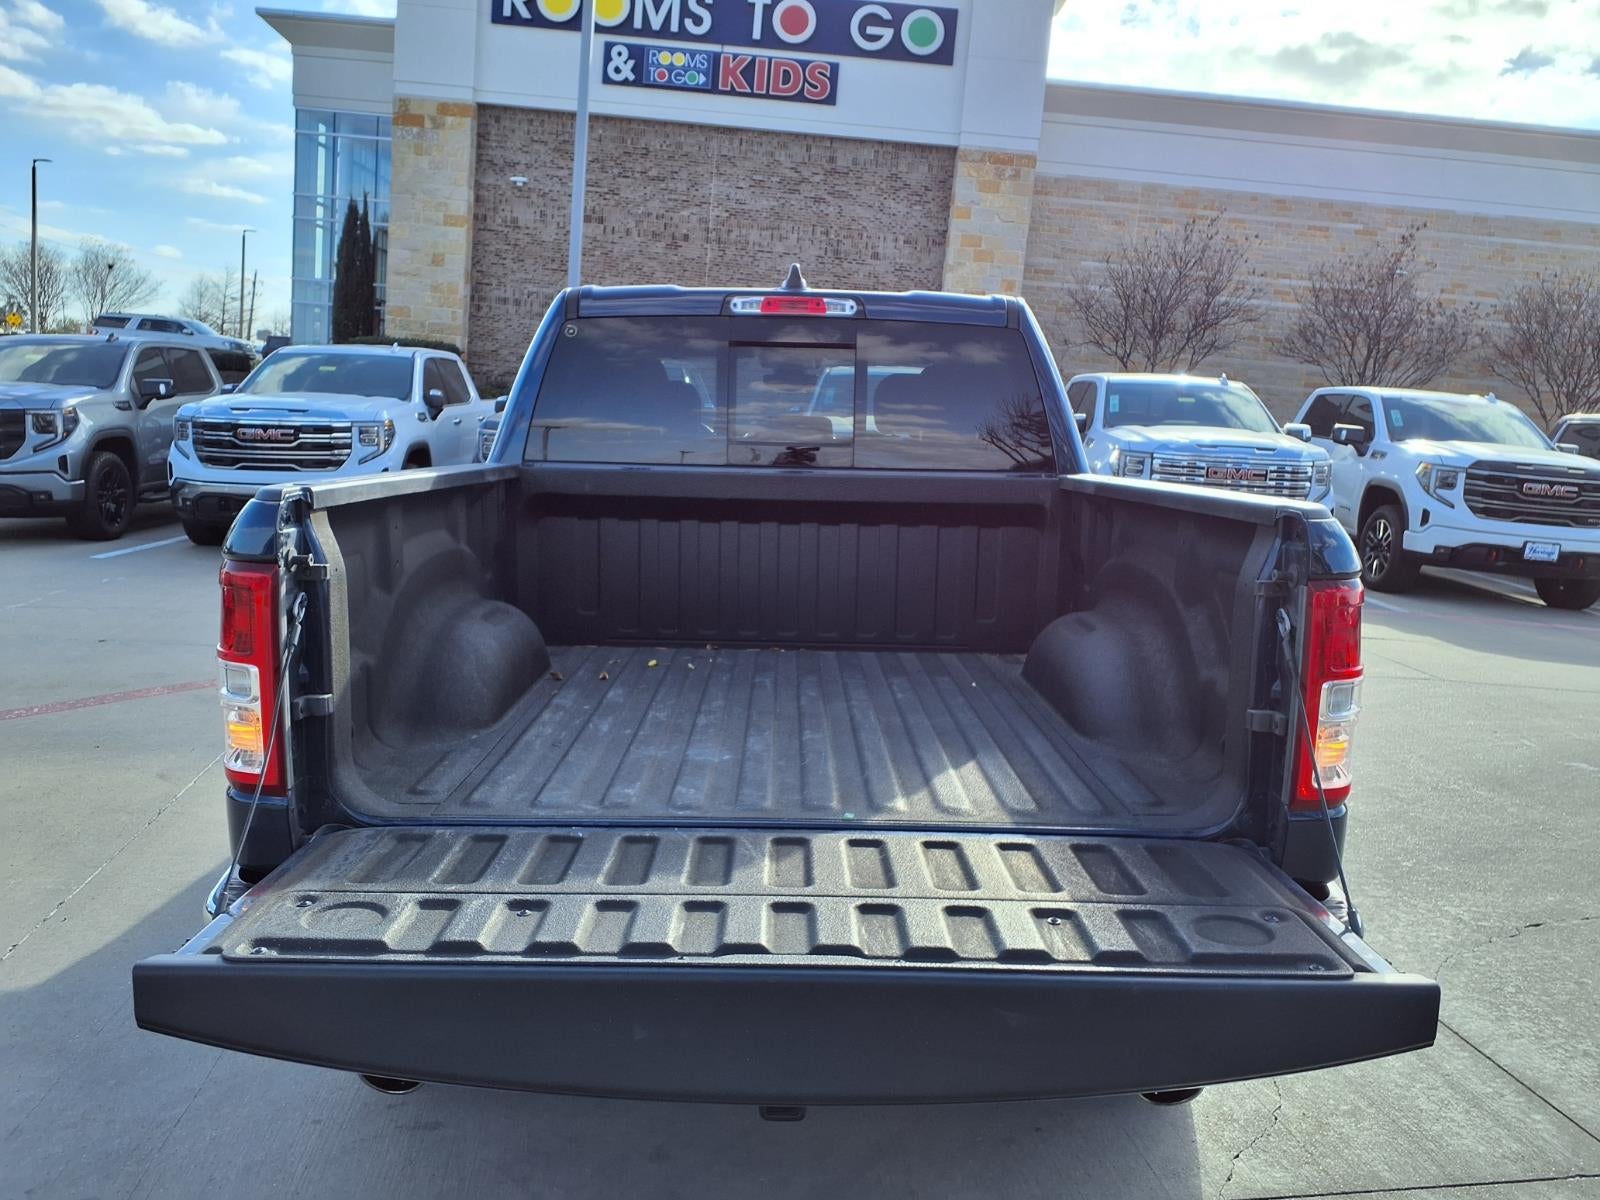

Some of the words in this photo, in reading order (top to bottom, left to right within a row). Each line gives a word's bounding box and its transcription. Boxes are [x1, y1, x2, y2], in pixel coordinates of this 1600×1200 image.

[747, 0, 817, 44] TO
[850, 4, 945, 56] GO
[607, 44, 636, 82] &
[648, 50, 708, 69] ROOMS
[649, 67, 669, 83] TO
[671, 70, 700, 86] GO
[718, 53, 831, 100] KIDS
[236, 427, 295, 441] GMC
[1208, 467, 1266, 481] GMC
[1523, 482, 1579, 498] GMC
